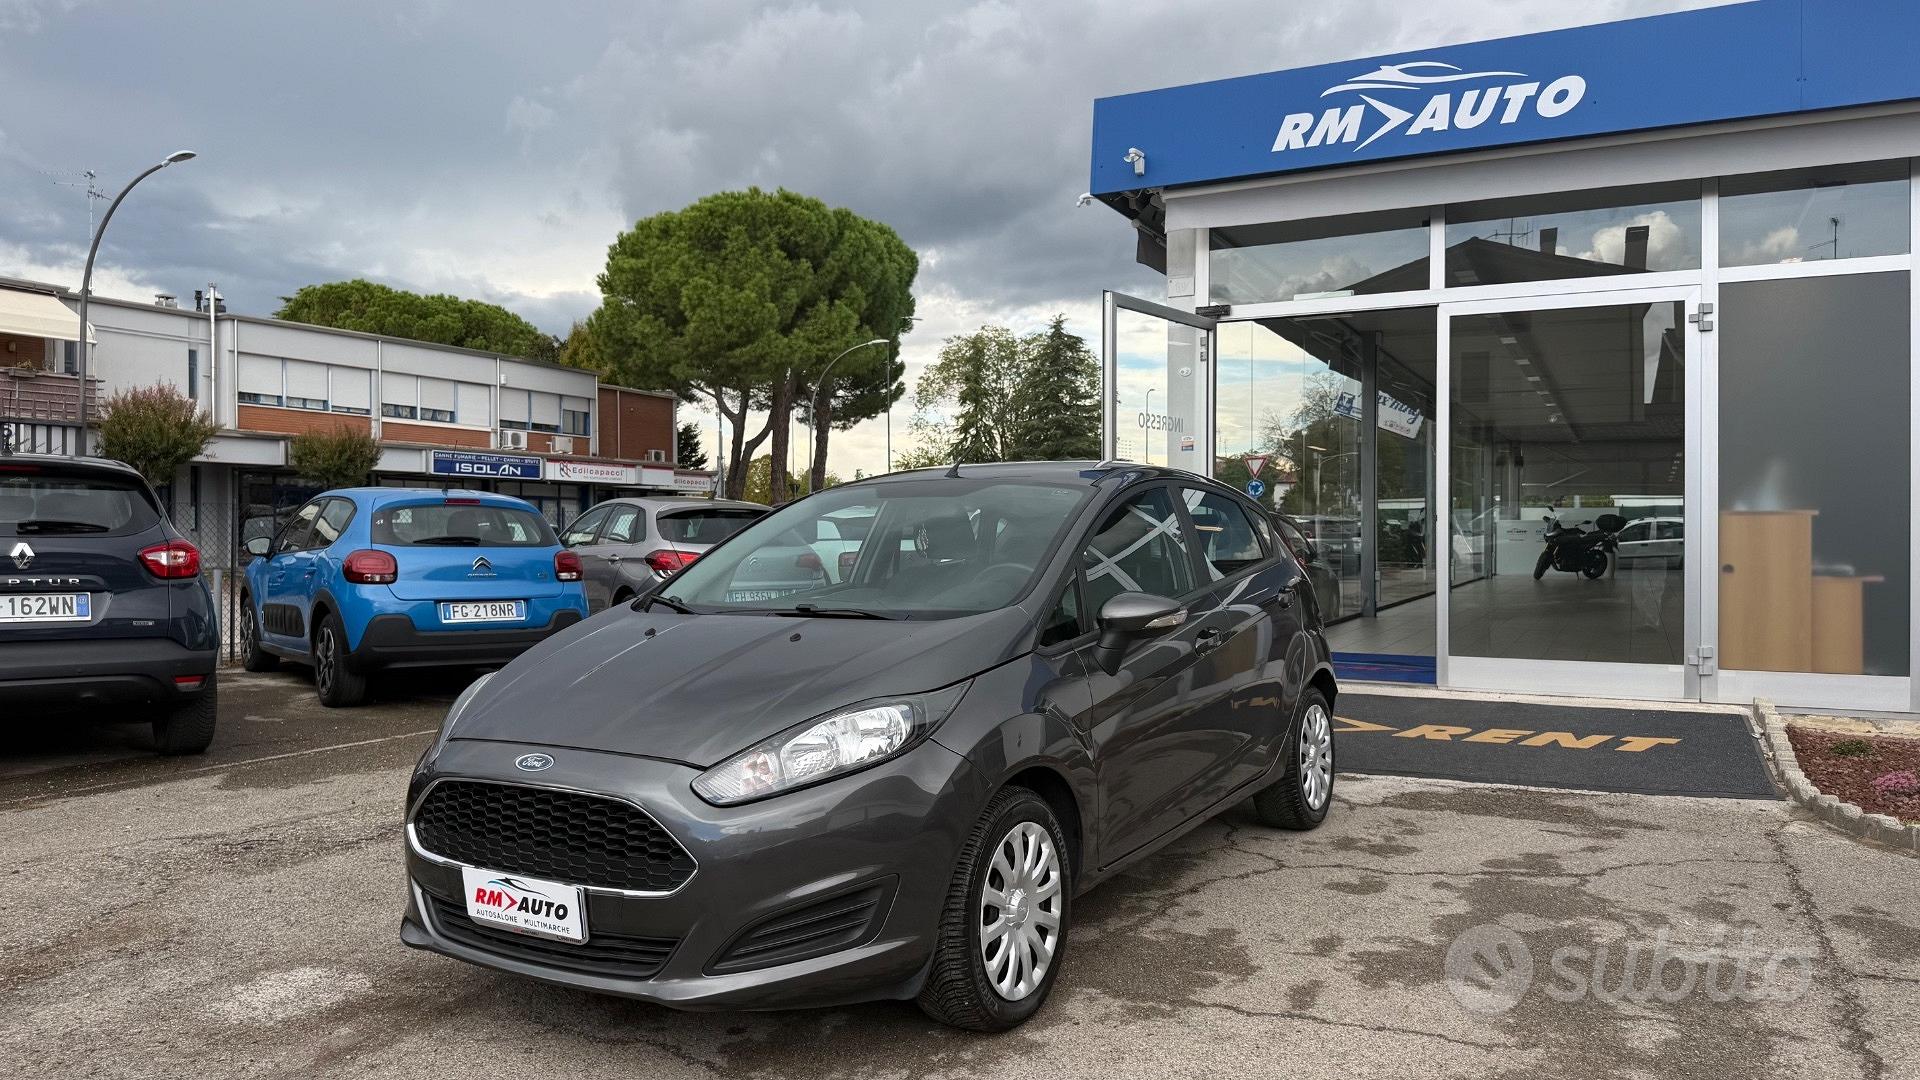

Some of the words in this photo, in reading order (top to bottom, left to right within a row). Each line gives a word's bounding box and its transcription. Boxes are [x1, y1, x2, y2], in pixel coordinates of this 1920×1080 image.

[1271, 104, 1365, 152] RM
[1405, 75, 1586, 136] AUTO
[455, 462, 521, 476] ISOLAN
[674, 478, 708, 486] dilcapacci
[8, 578, 80, 586] PTUR
[1392, 724, 1683, 752] RENT
[475, 888, 503, 908] RM
[517, 896, 569, 921] AUTO
[476, 908, 518, 923] AUTOSALONE
[524, 918, 570, 935] MULTIMARCHE
